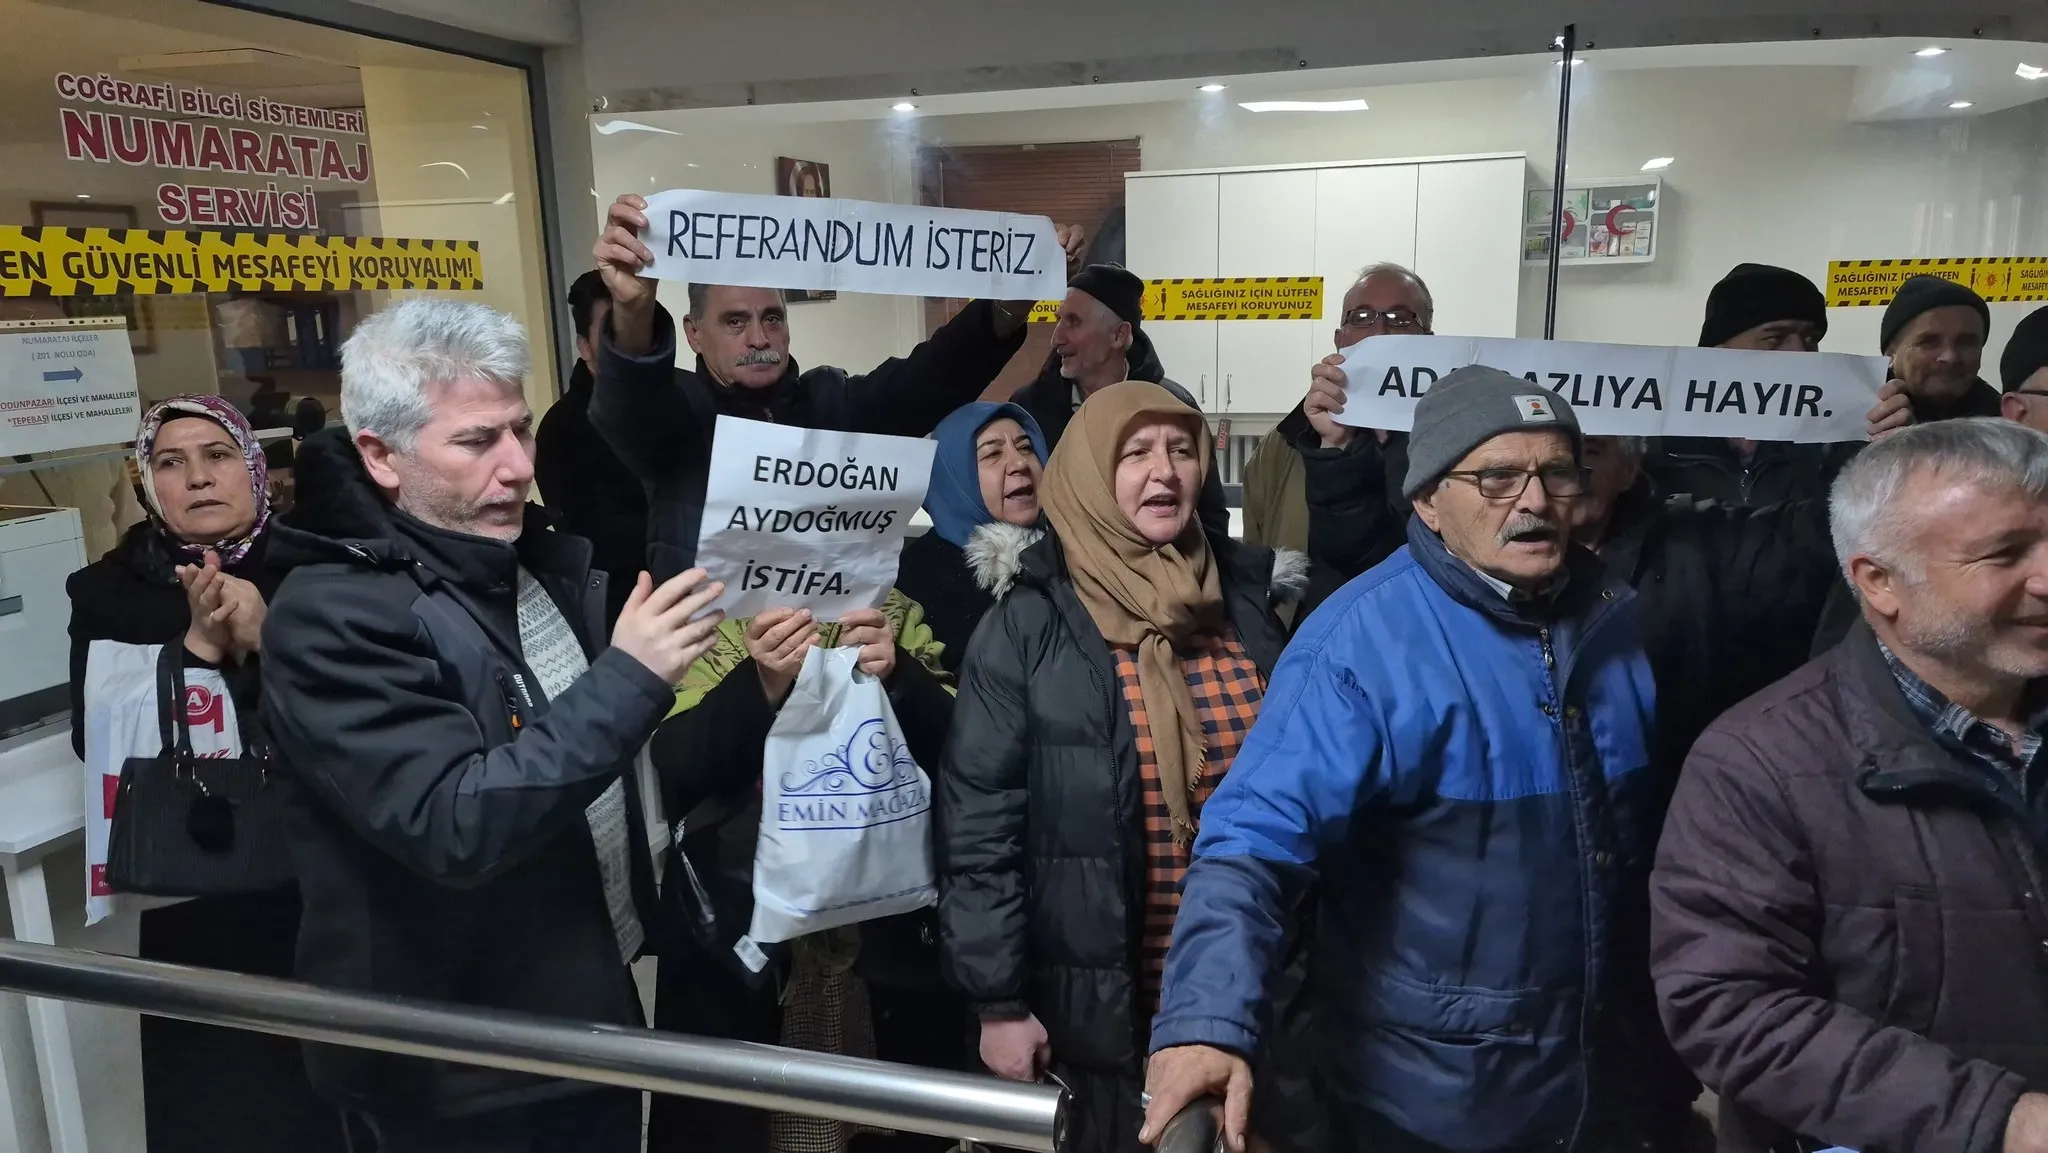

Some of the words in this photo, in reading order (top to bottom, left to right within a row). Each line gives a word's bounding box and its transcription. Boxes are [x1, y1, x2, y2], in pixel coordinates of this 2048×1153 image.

[56, 74, 174, 110] COĞRAFİ
[180, 88, 242, 118] BİLGİ
[248, 98, 365, 133] SİSTEMLERİ
[62, 110, 371, 182] NUMARATAJ
[159, 183, 317, 227] SERVİSİ
[667, 209, 913, 268] REFERANDUM
[925, 219, 1043, 275] İSTERİZ.
[62, 245, 201, 280] GÜVENLİ
[212, 250, 340, 279] MESAFEYİ
[349, 255, 473, 279] KORUYALIM!
[1834, 270, 1898, 284] SAĞLIĞINIZ
[1181, 287, 1246, 299] SAĞLIĞINIZ
[1249, 286, 1273, 300] İÇİN
[1276, 286, 1318, 298] LÜTFEN
[1186, 300, 1237, 311] MESAFEYİ
[1241, 300, 1313, 311] KORUYUNUZ
[1837, 284, 1889, 297] MESAFEYİ
[56, 394, 79, 406] İLÇESİ
[80, 395, 90, 403] VE
[91, 391, 137, 402] MAHALLELERİ
[75, 411, 85, 419] VE
[86, 405, 133, 418] MAHALLELERİ
[1684, 380, 1834, 418] HAYIR.
[753, 455, 899, 492] ERDOĞAN
[726, 505, 898, 534] AYDOĞMUŞ
[740, 559, 851, 596] İSTİFA.
[777, 799, 847, 822] EMİN
